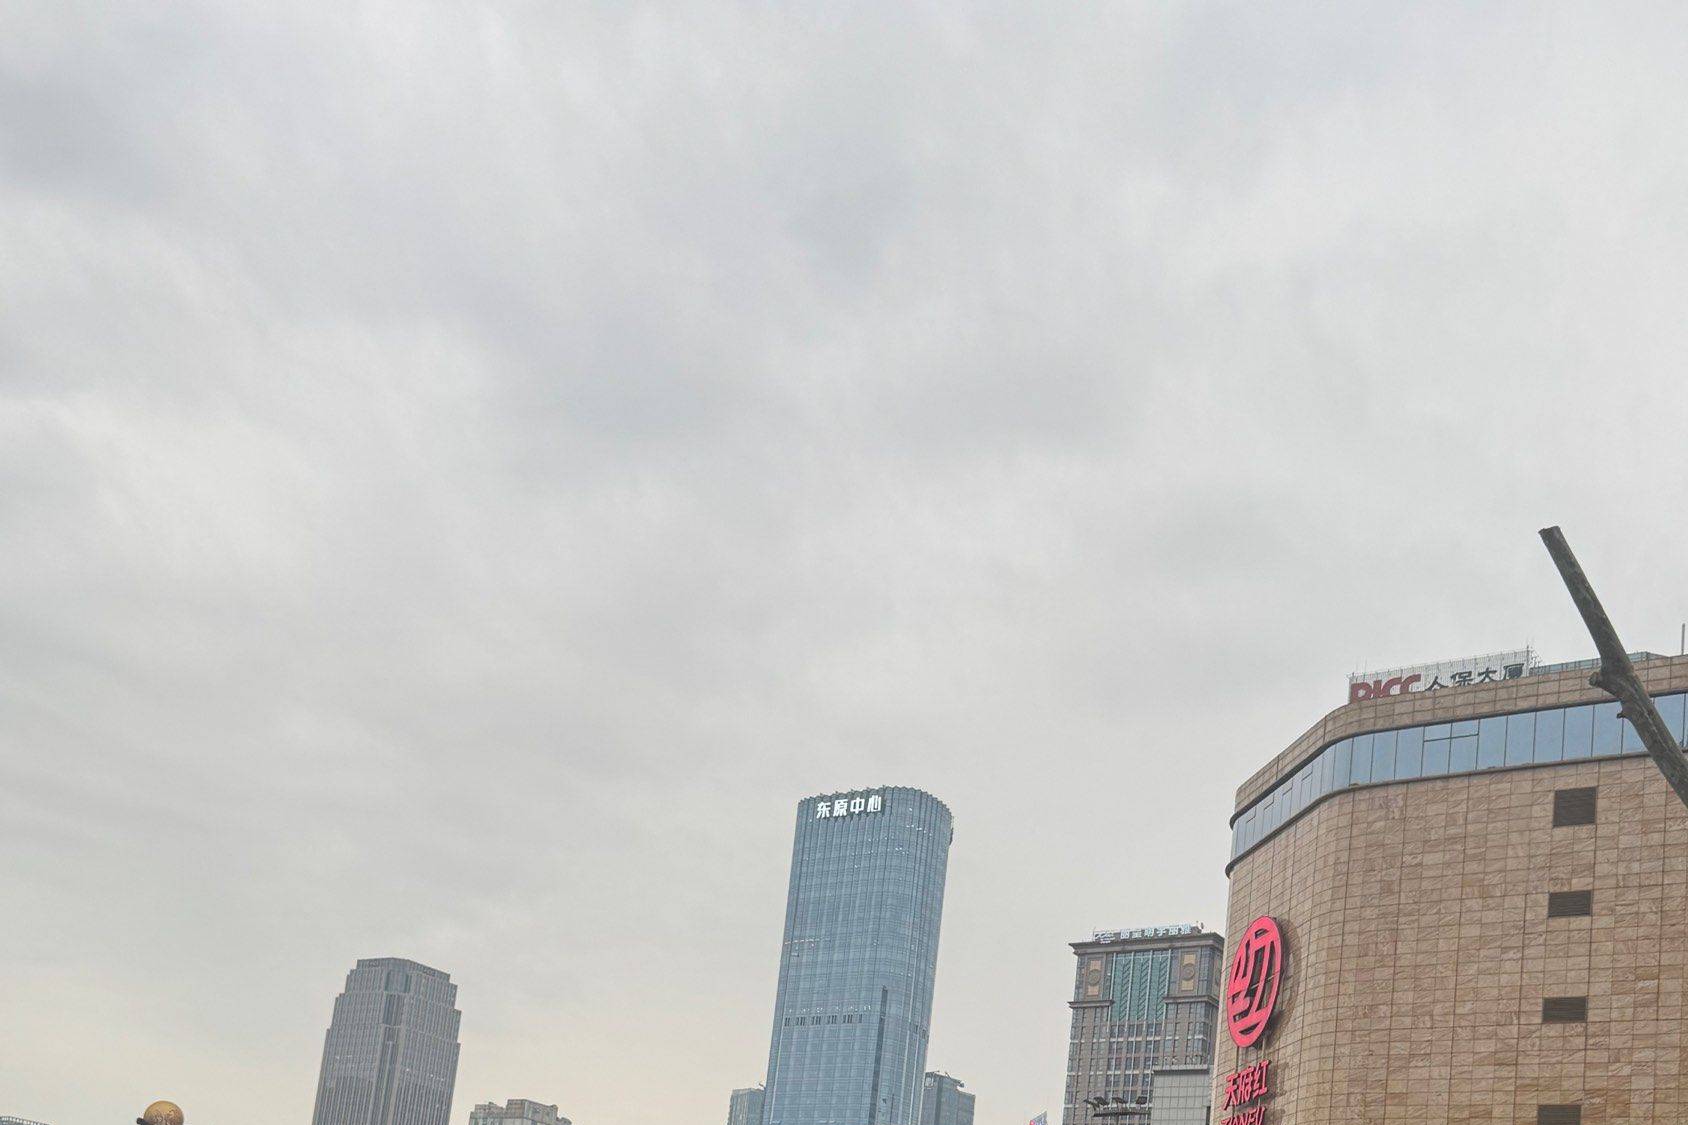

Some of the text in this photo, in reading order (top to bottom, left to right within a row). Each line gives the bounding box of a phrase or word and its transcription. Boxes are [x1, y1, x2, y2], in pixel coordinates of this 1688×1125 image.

[1424, 662, 1525, 692] 人保大厦
[816, 795, 882, 819] 东原中心
[1222, 1060, 1269, 1110] 天府红
